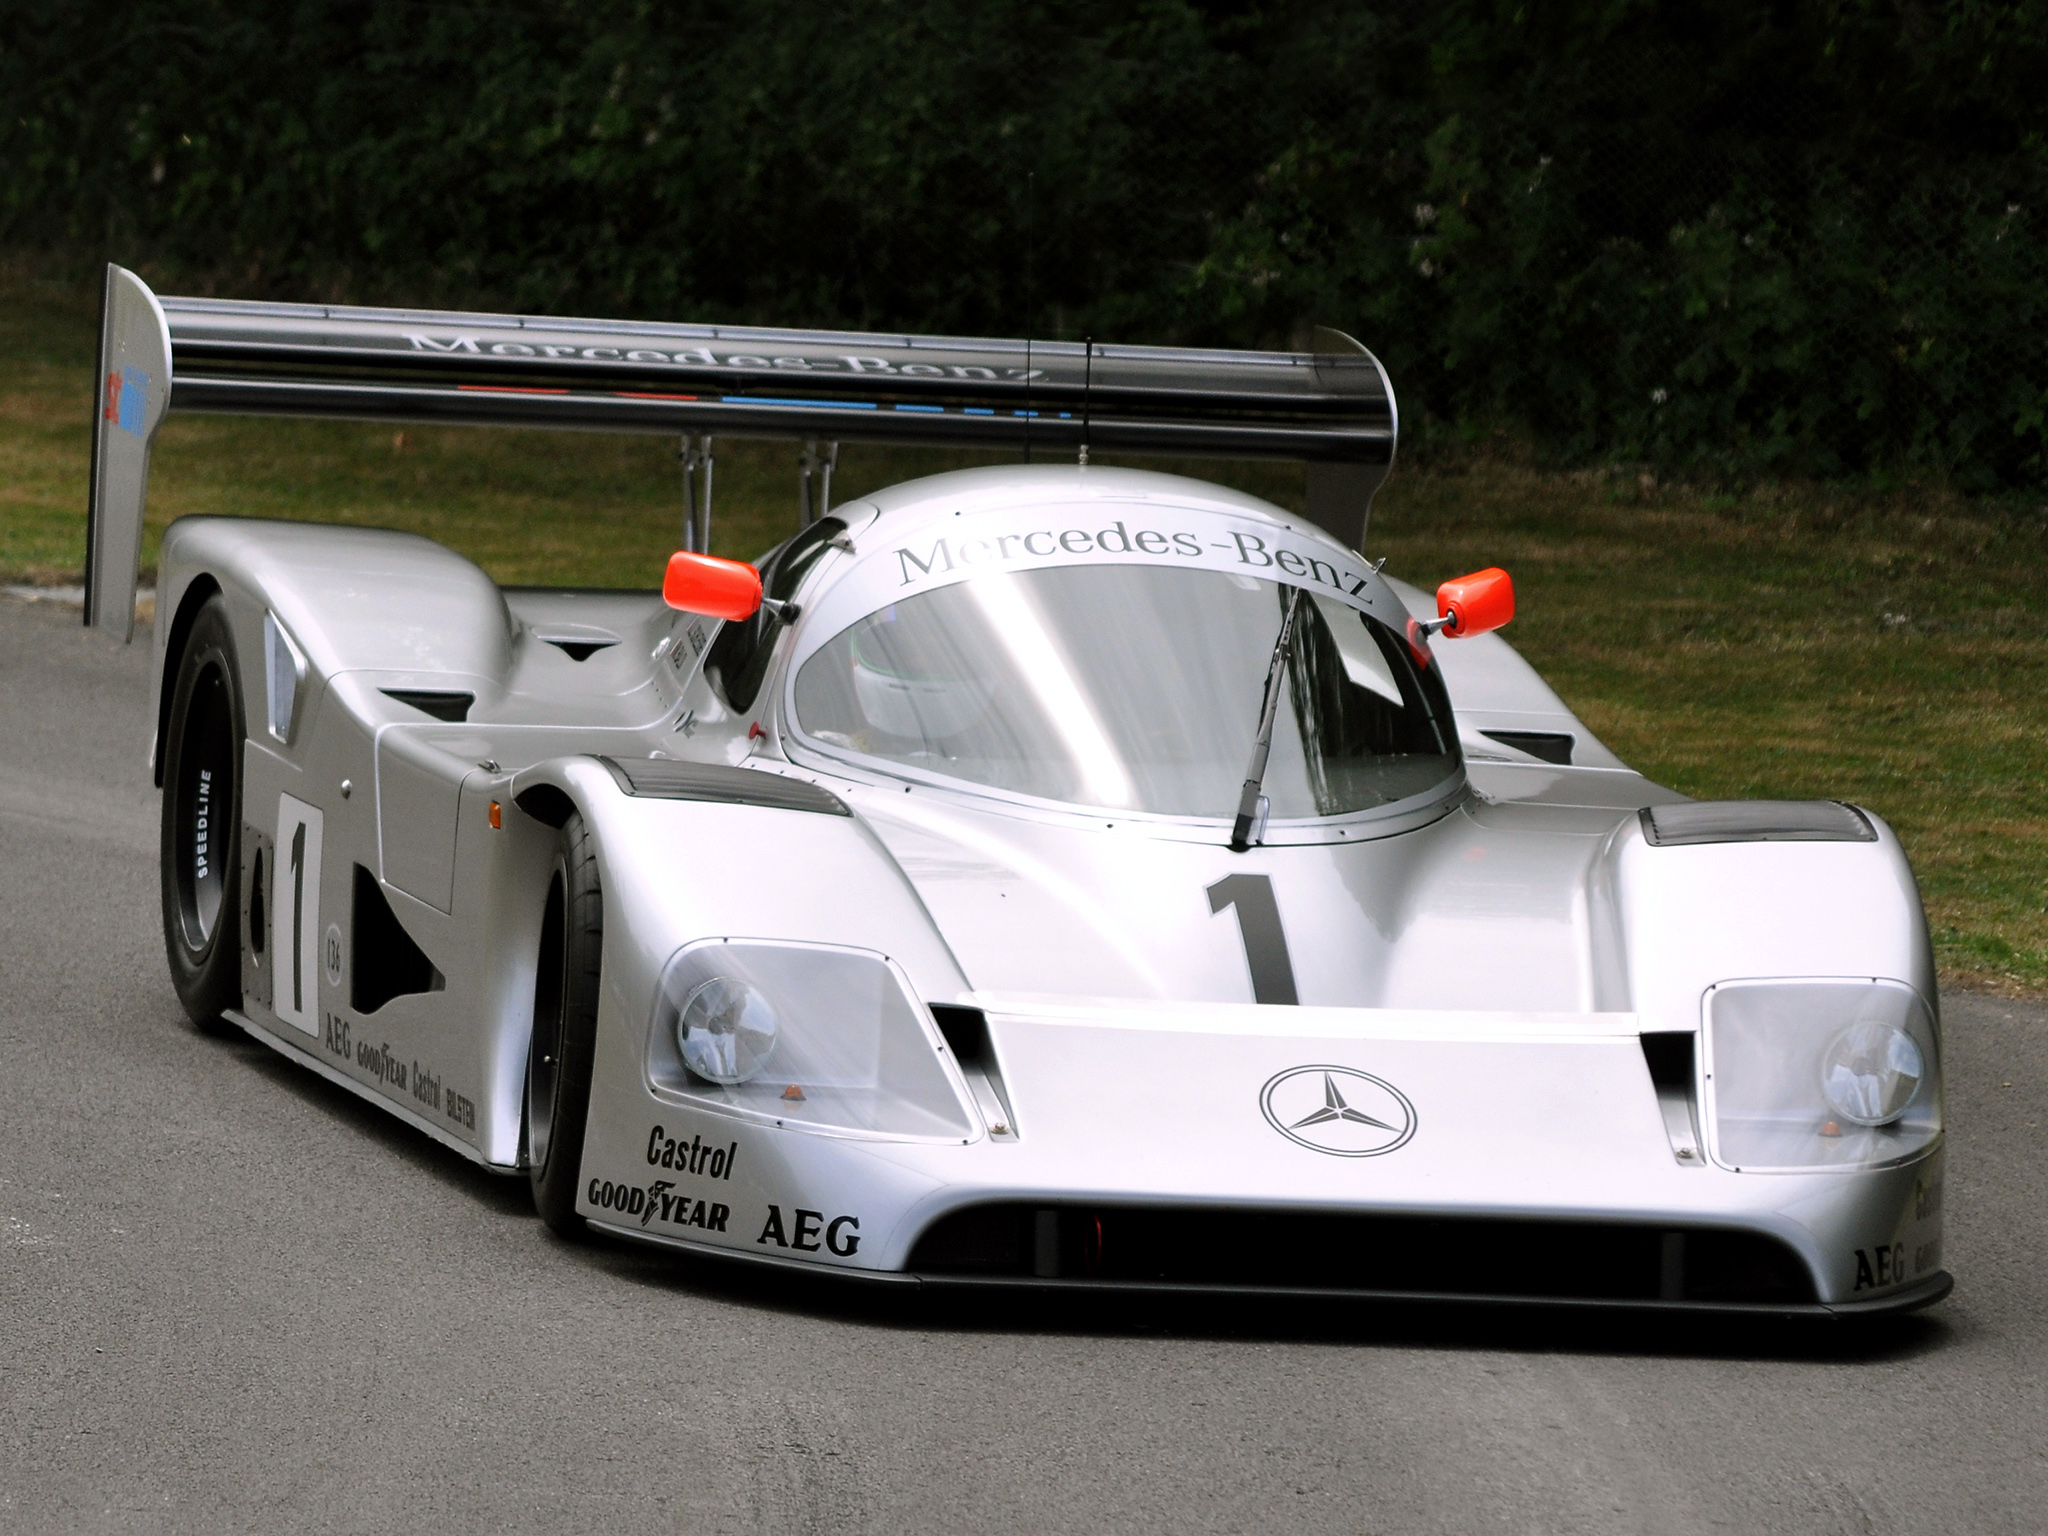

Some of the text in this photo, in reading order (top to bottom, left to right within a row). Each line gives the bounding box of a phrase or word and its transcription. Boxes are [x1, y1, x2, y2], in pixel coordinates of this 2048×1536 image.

[893, 521, 1374, 605] Mercedes-Benz
[197, 769, 212, 878] SPEEDLINE
[290, 821, 306, 1014] 1
[1204, 872, 1300, 1006] 1
[326, 1012, 351, 1061] AEG
[357, 1042, 407, 1091] GOODYEAR
[413, 1060, 440, 1112] Castrol
[647, 1125, 738, 1181] Castrol
[588, 1180, 731, 1233] GOODYEAR
[757, 1204, 861, 1257] AEG
[1853, 1242, 1905, 1292] AEG
